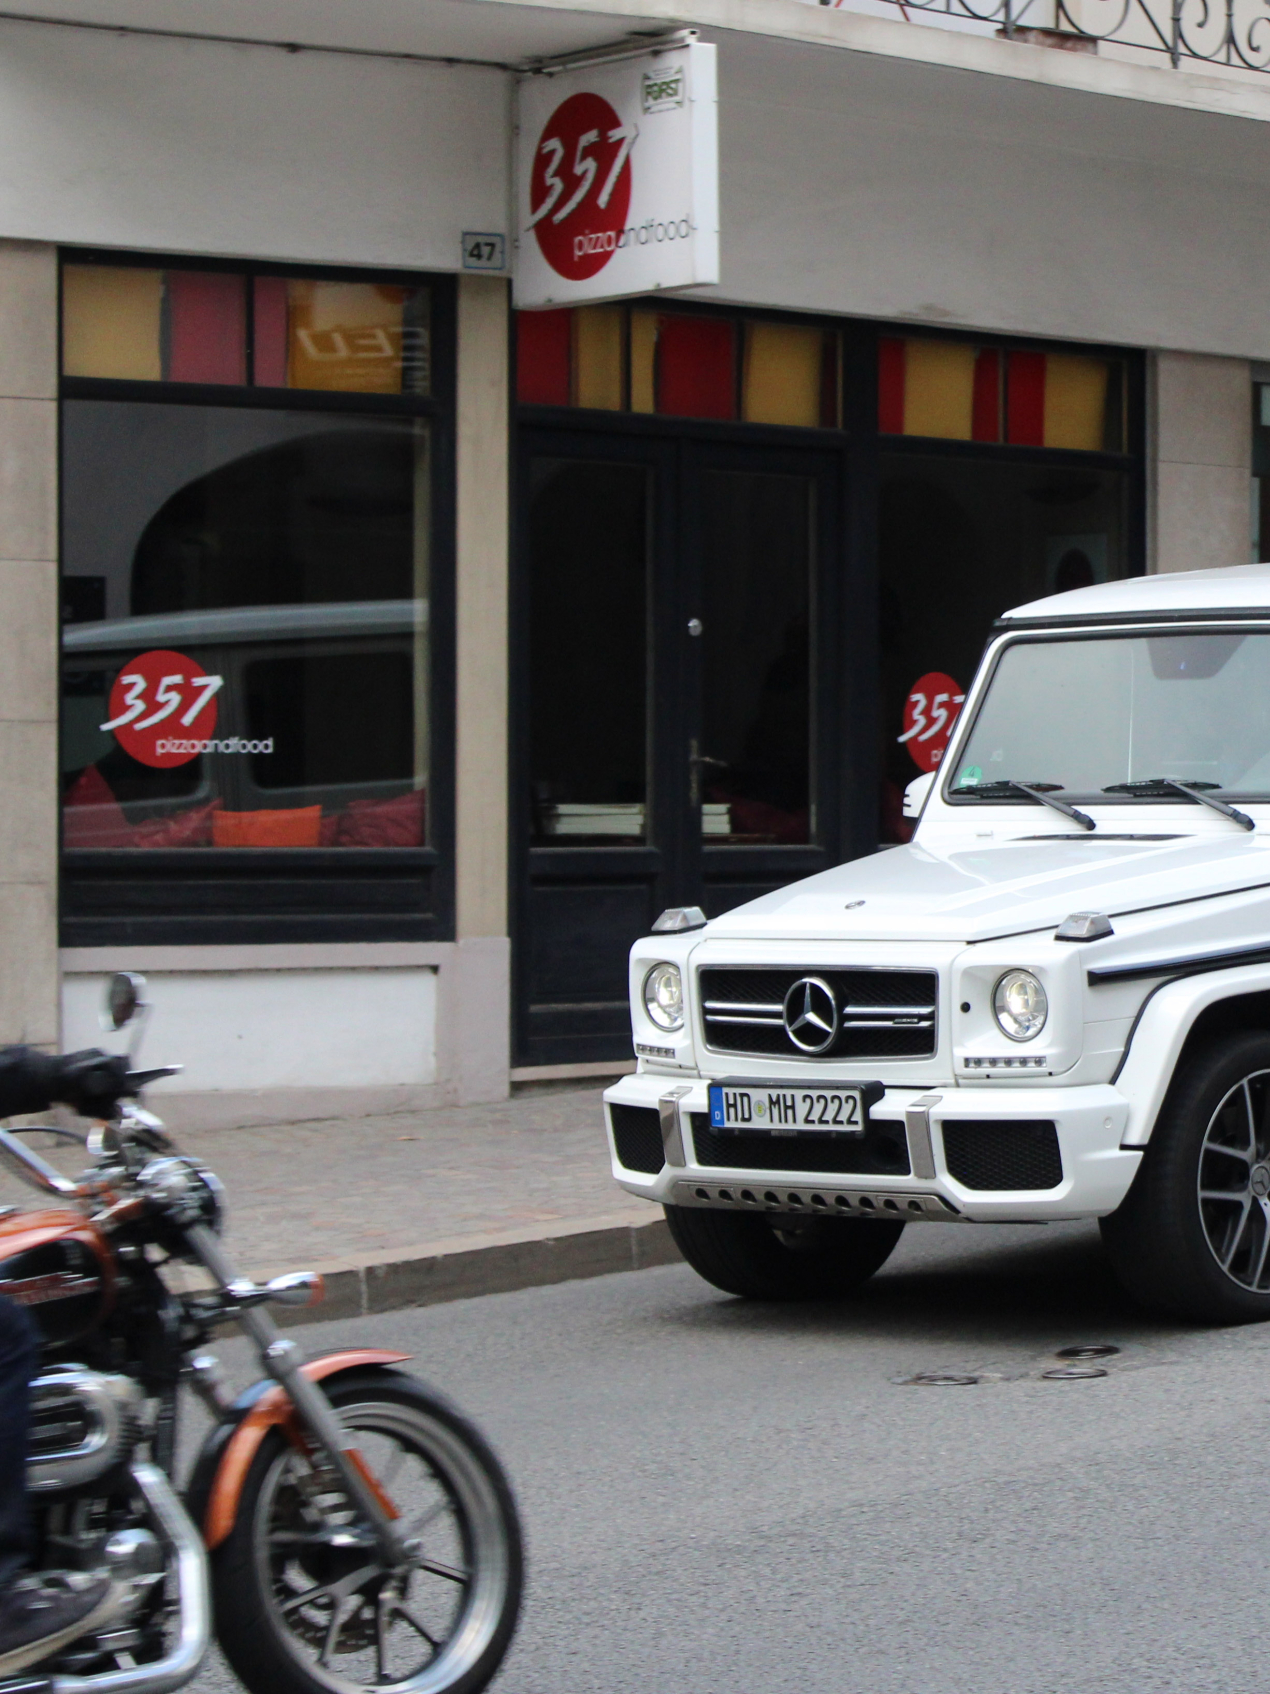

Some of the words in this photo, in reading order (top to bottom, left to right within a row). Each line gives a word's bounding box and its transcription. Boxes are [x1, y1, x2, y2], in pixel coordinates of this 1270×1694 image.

[524, 122, 640, 232] 357
[468, 241, 496, 261] 47
[99, 673, 224, 732] 357
[155, 737, 274, 756] pizzaandfood
[725, 1091, 752, 1123] HD
[768, 1093, 797, 1124] MH
[801, 1094, 859, 1125] 2222
